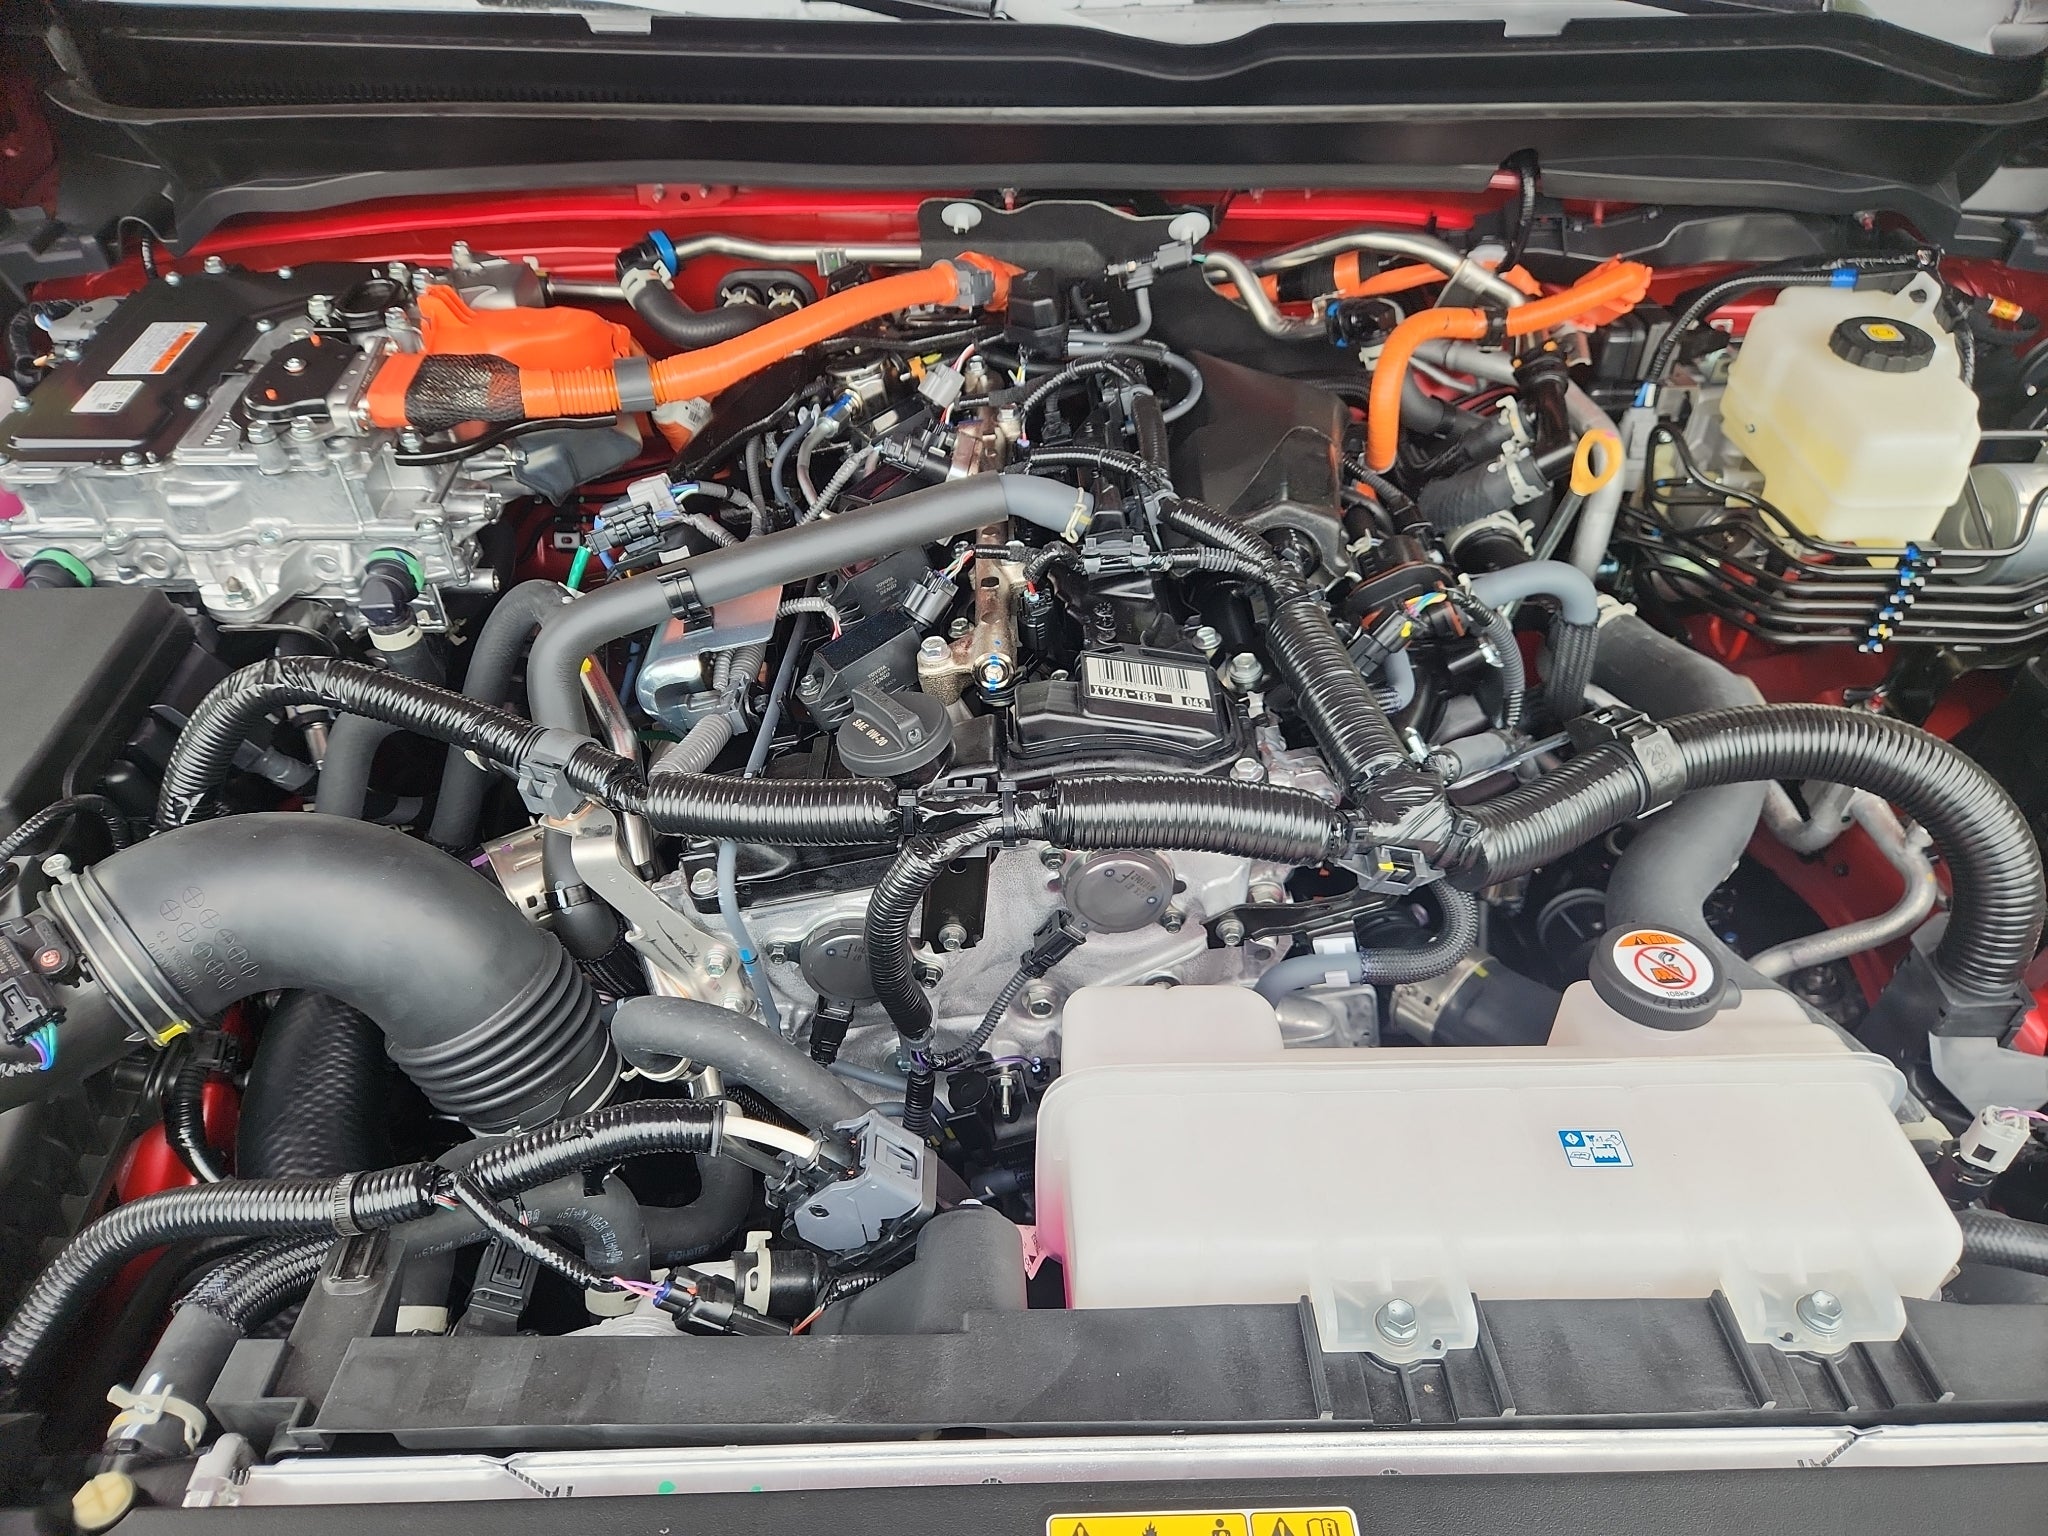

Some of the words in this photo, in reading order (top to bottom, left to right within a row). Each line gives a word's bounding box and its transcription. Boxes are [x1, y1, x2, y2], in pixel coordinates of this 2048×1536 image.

[867, 664, 888, 678] TOYOTA
[873, 672, 891, 686] DENSO
[1093, 684, 1156, 702] XT24A-T83
[1185, 697, 1207, 709] 043
[852, 718, 868, 732] SAE
[865, 728, 889, 747] 0W-20
[1644, 742, 1667, 767] 28
[1665, 990, 1697, 998] 108kPa
